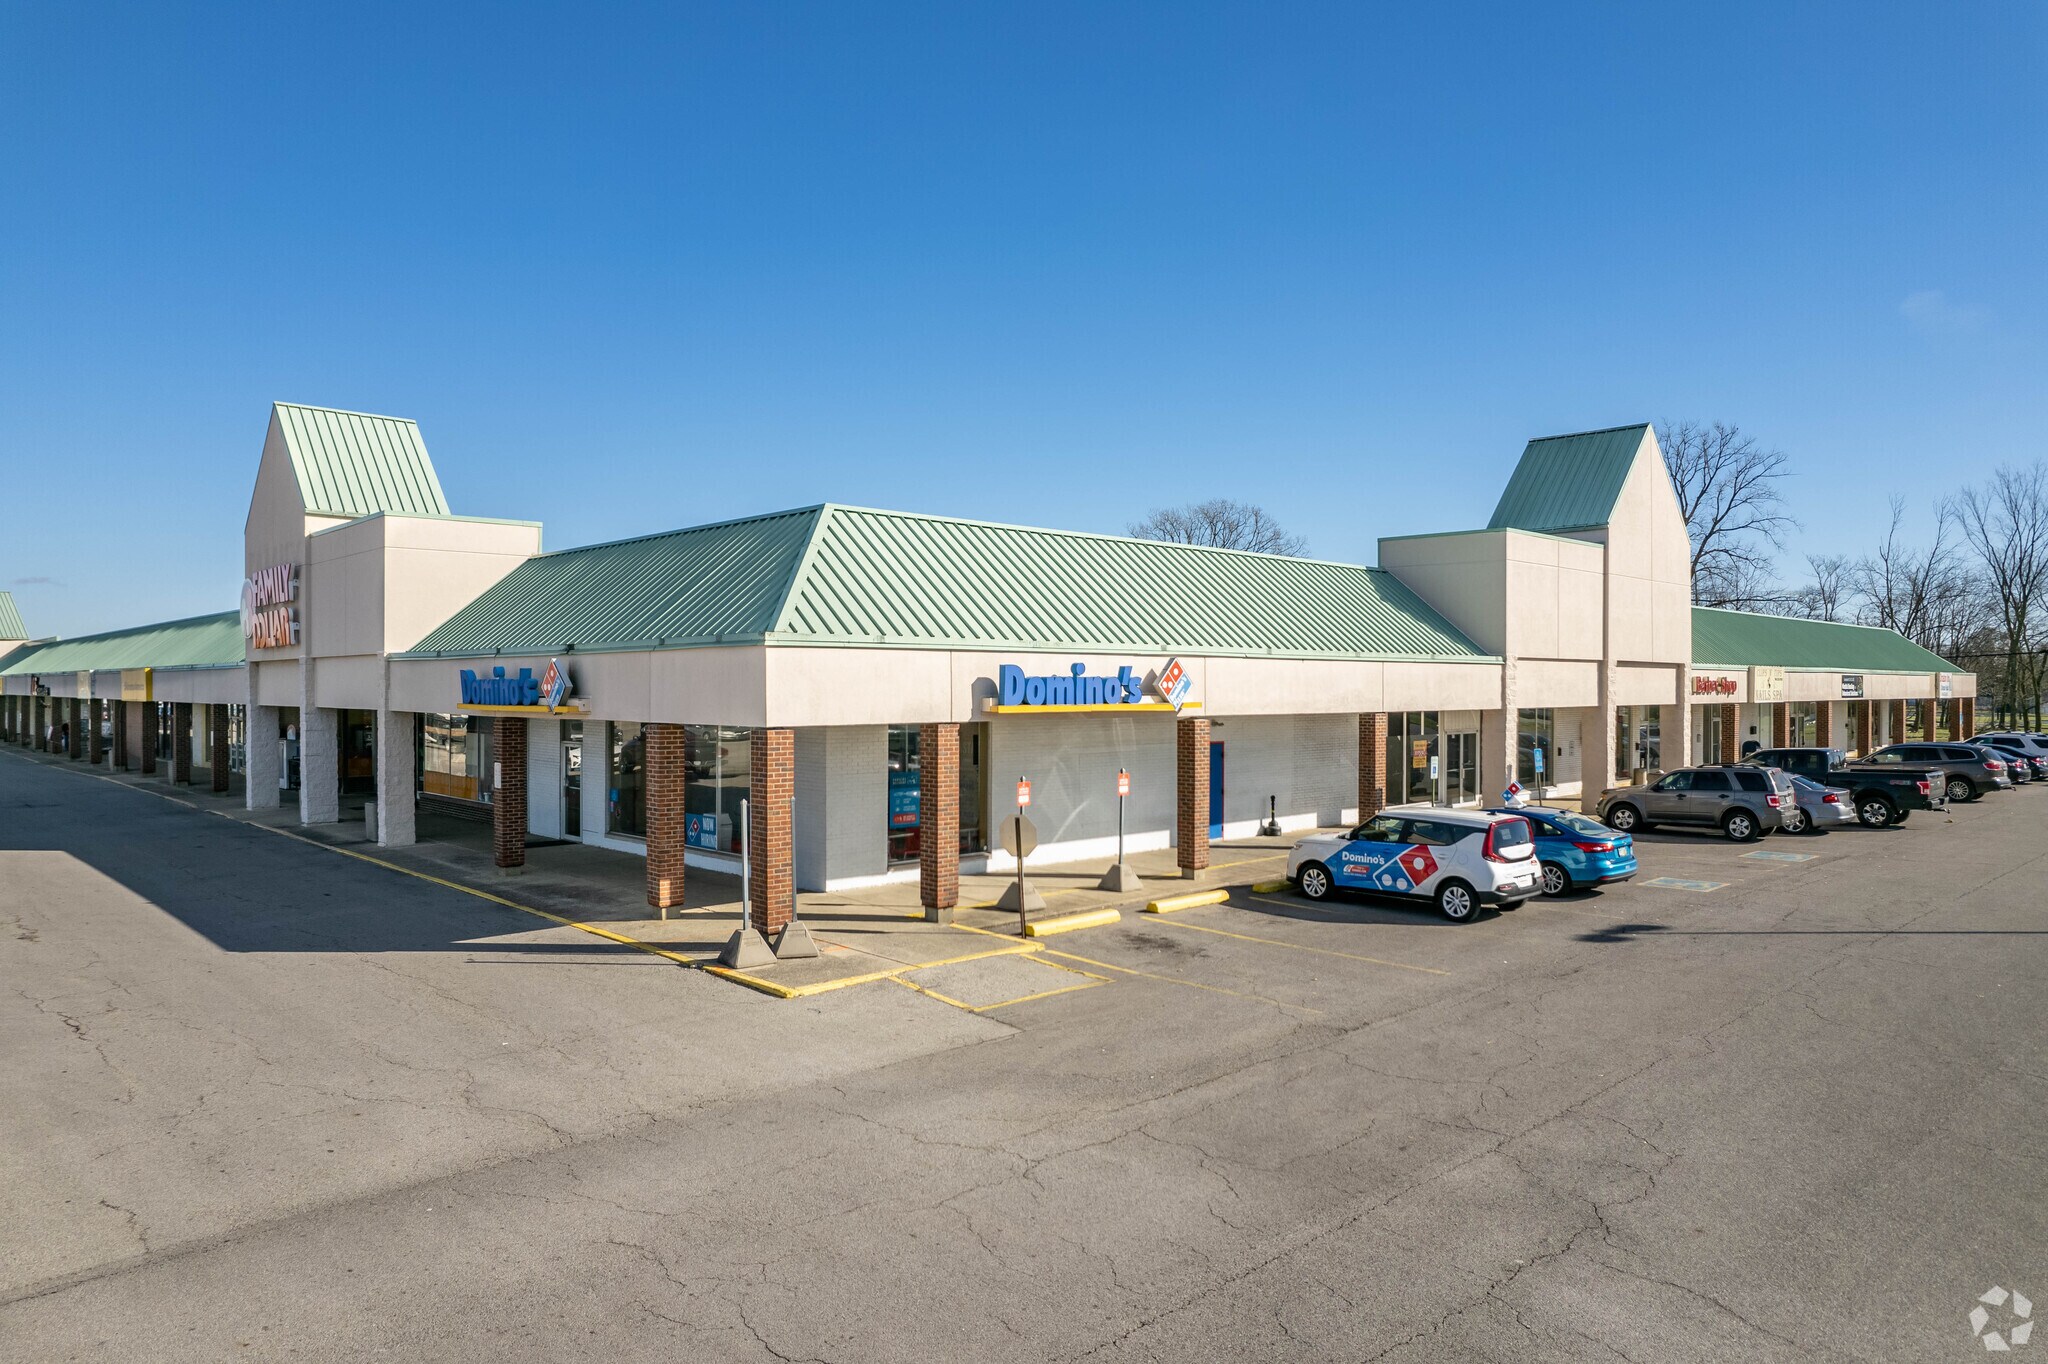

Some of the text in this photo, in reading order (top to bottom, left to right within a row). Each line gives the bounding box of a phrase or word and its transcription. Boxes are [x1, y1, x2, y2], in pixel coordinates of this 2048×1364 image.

[252, 563, 291, 607] FAMILY
[253, 607, 290, 649] DOLLAR
[460, 666, 539, 706] Domino's
[999, 662, 1143, 706] Domino's
[1718, 676, 1737, 694] Shop
[1772, 690, 1783, 701] SPA
[703, 817, 714, 832] NOW
[1342, 851, 1385, 865] Domino's
